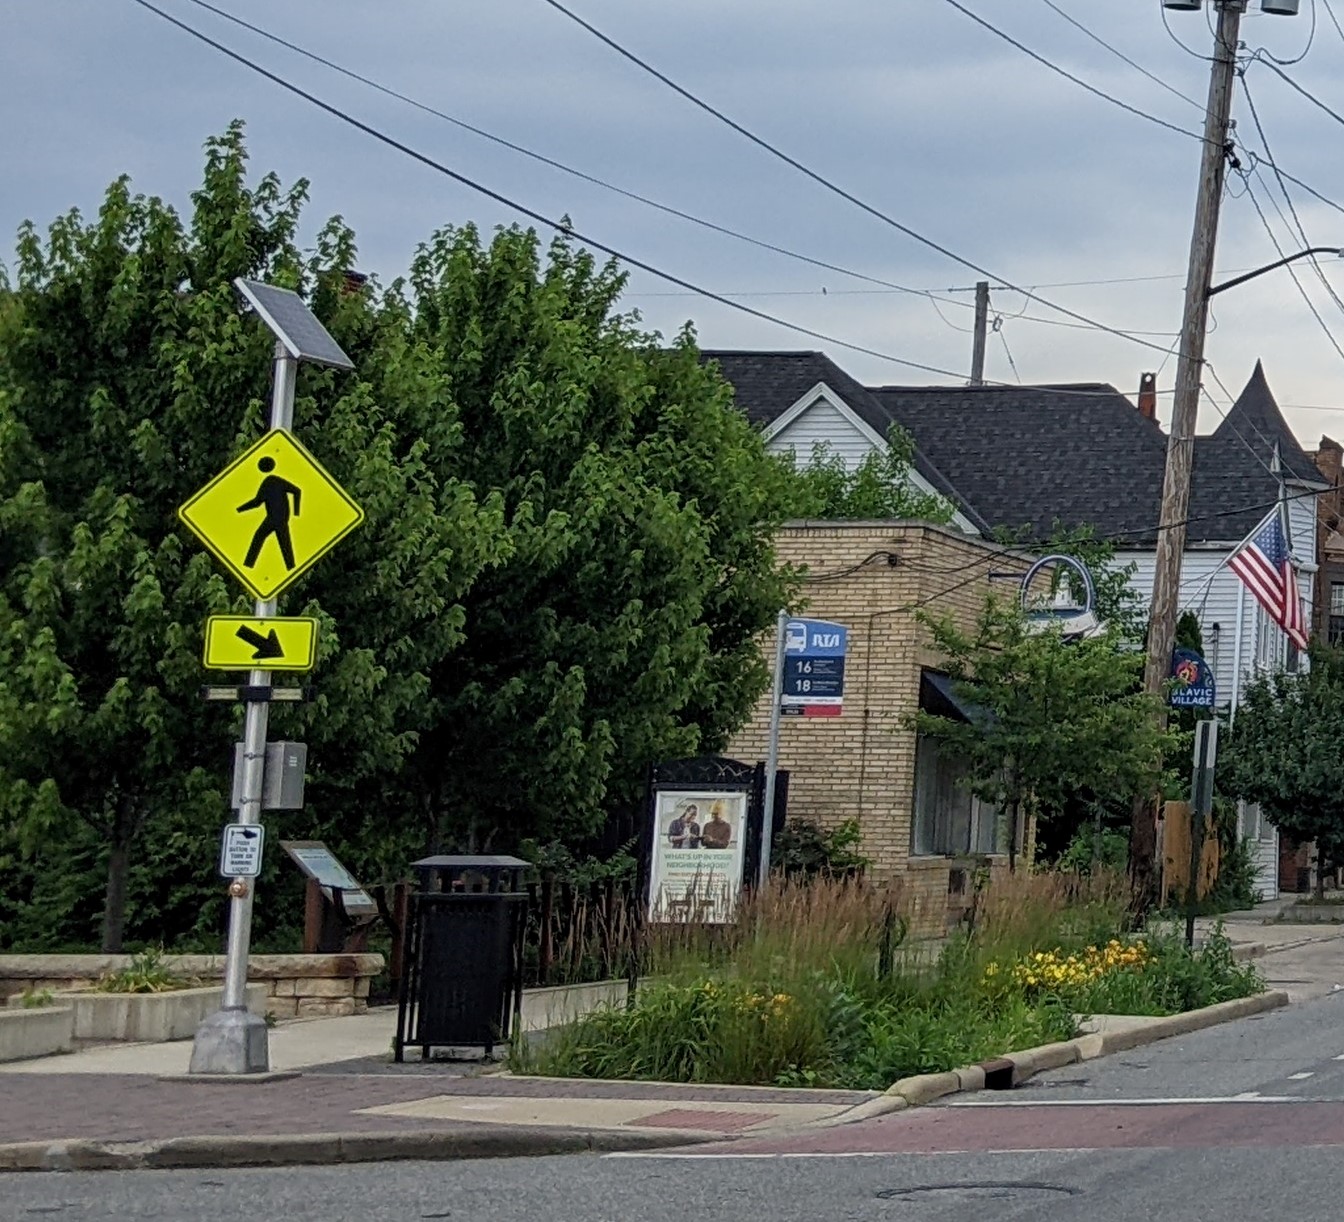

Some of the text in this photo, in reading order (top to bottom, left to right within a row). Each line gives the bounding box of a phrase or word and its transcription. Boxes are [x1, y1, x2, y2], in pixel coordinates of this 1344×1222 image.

[812, 633, 840, 648] RTA
[796, 661, 812, 674] 16
[795, 679, 811, 692] 18
[1171, 688, 1212, 697] SLAVIC
[1171, 696, 1212, 706] VILLAGE
